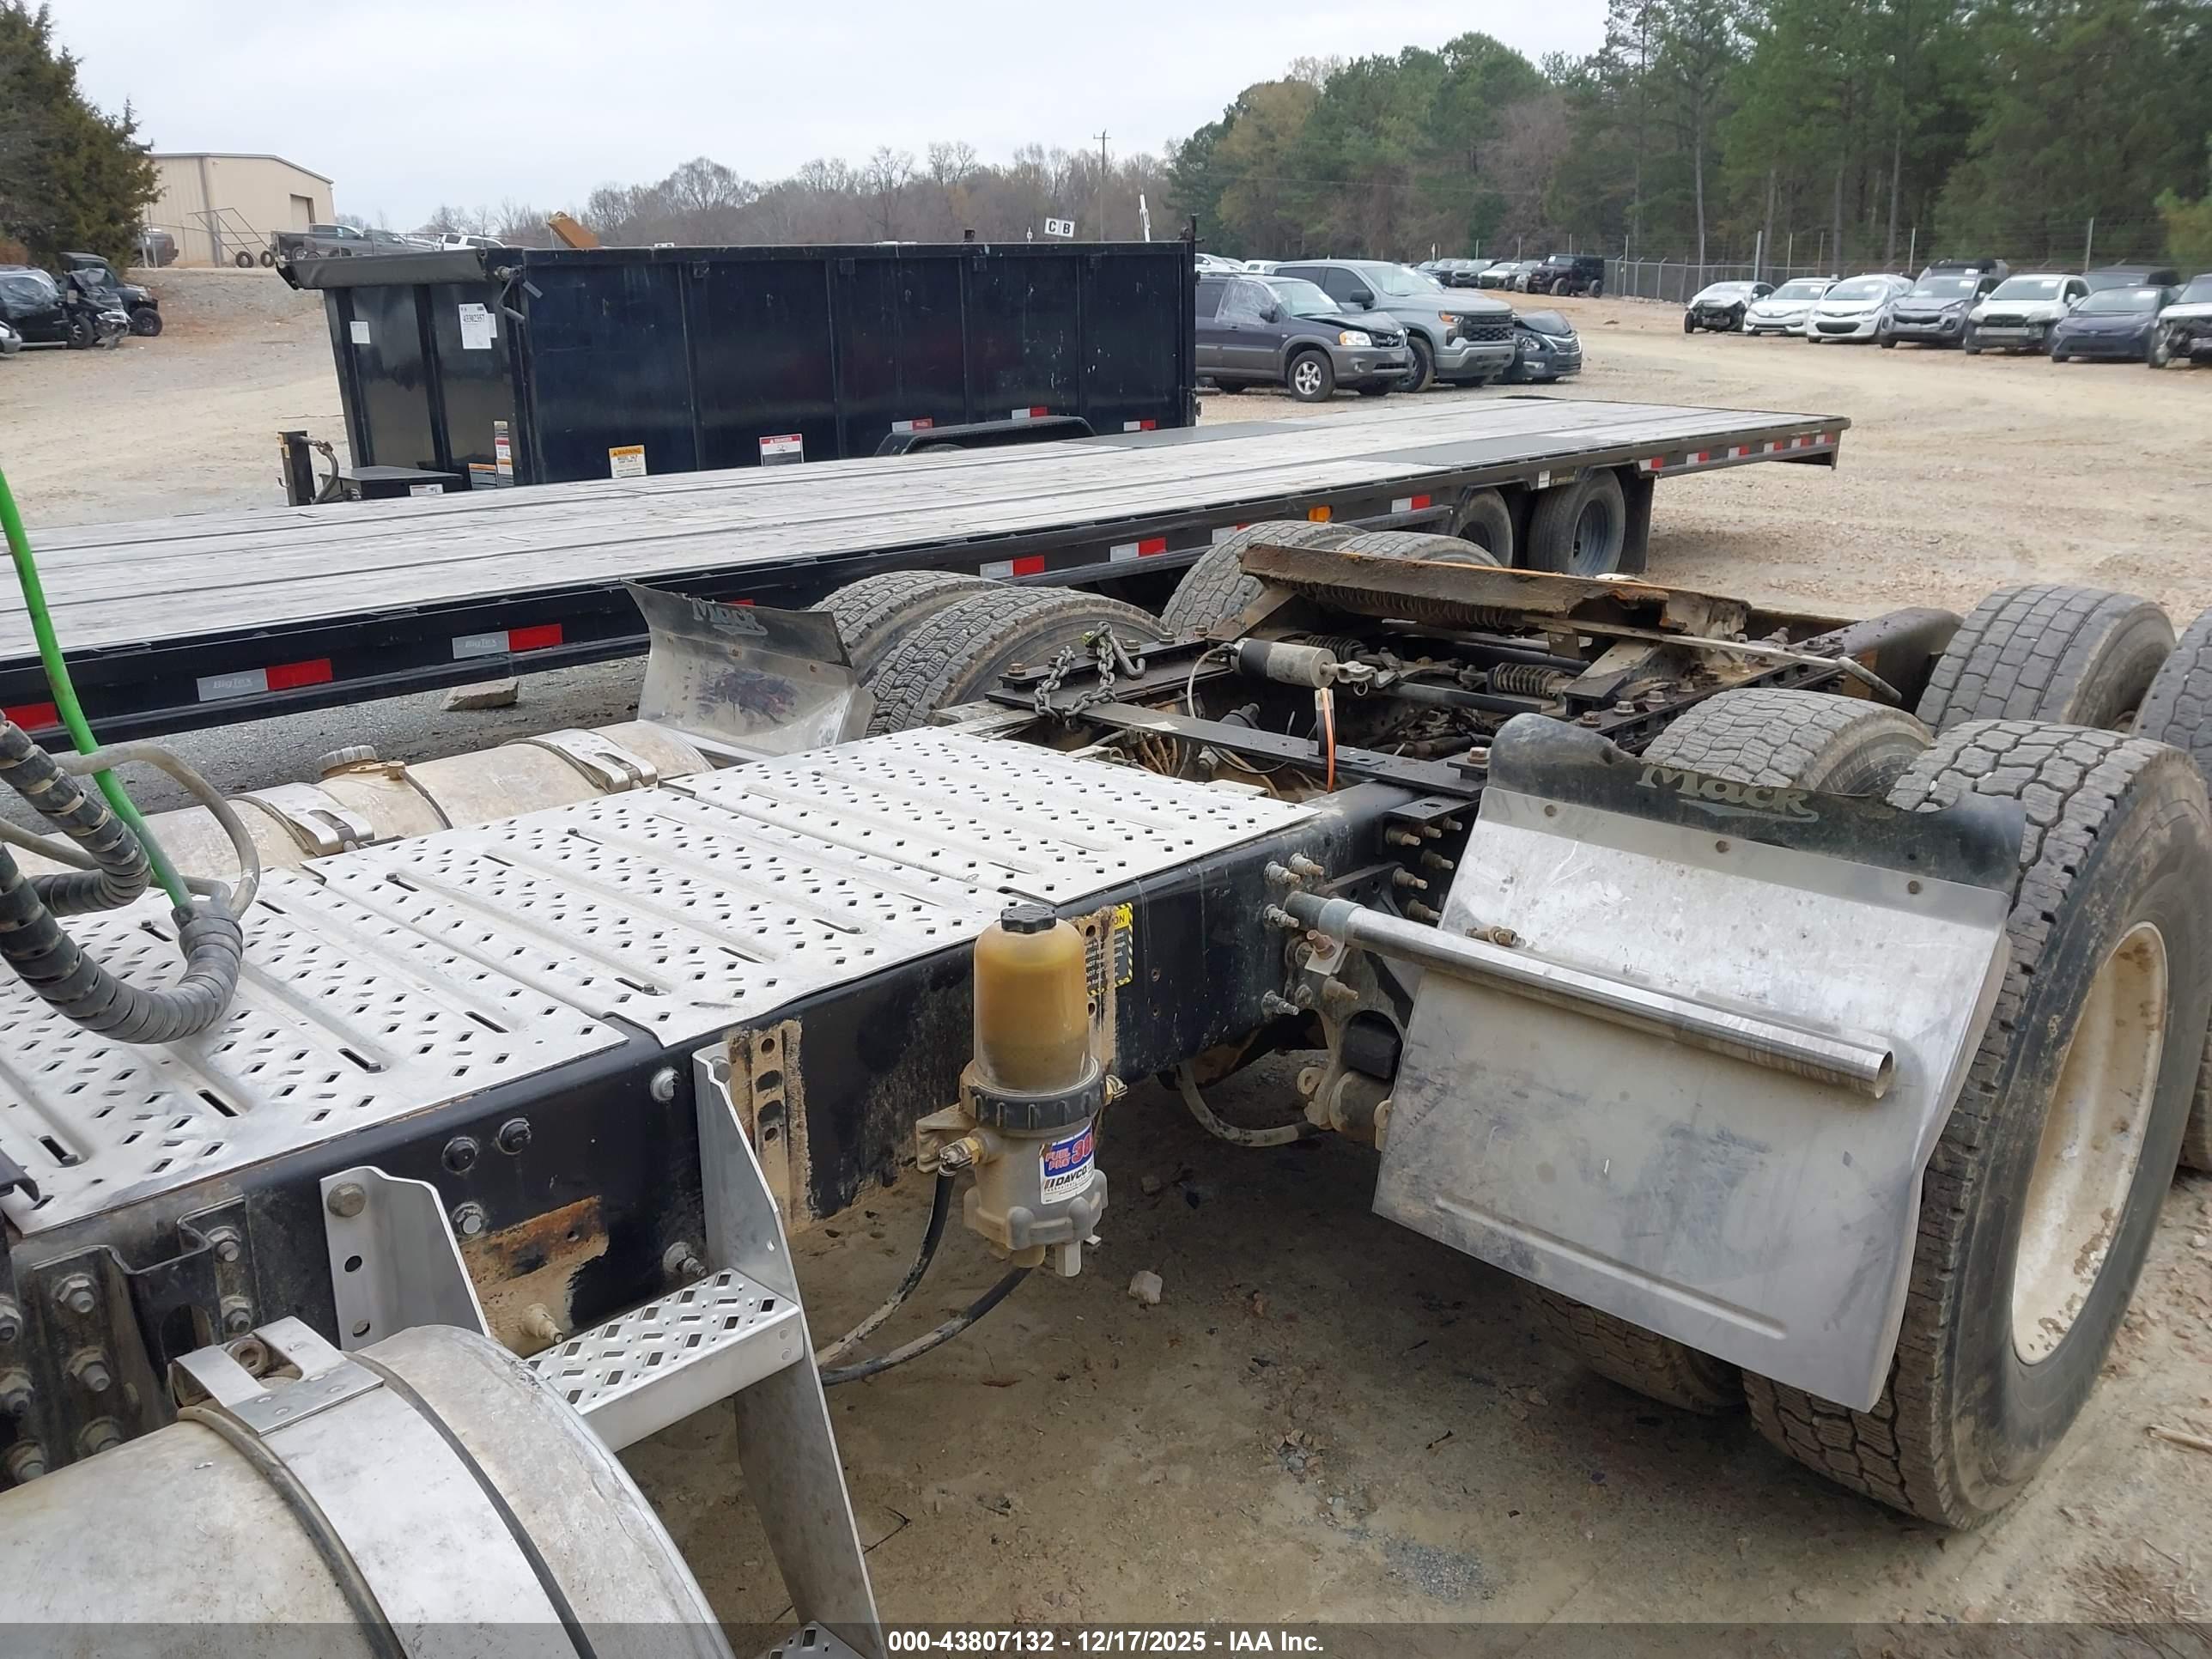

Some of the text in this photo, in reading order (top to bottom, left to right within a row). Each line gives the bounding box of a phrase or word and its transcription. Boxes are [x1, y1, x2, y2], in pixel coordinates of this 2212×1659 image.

[1048, 221, 1071, 234] C B
[1635, 763, 1819, 823] Mack
[1045, 1147, 1071, 1163] FUEL
[1048, 1158, 1070, 1170] PRO
[1055, 1165, 1088, 1187] DAVCO
